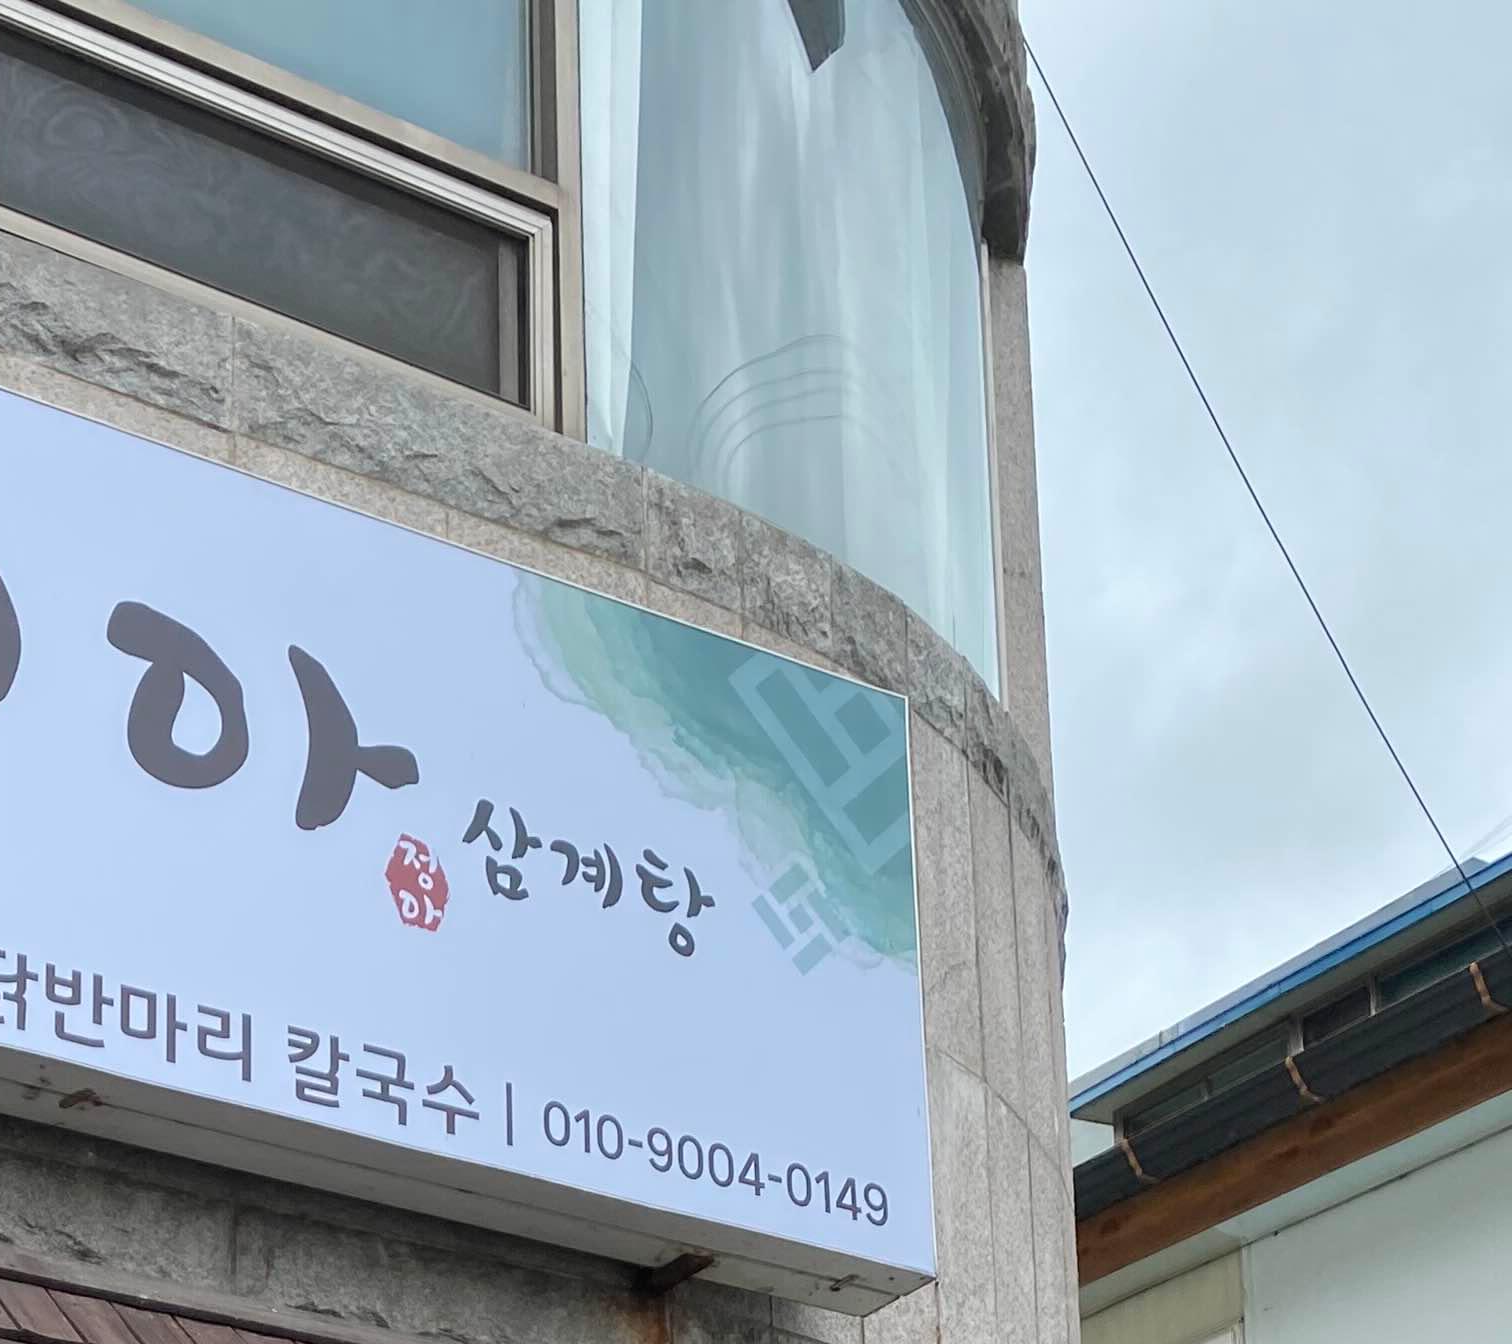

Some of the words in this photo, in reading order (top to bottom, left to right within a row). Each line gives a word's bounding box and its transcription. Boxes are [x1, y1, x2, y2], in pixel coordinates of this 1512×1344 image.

[462, 799, 716, 957] 삼계탕
[286, 1025, 480, 1135] 칼국수
[542, 1100, 890, 1227] 010-9004-0149
